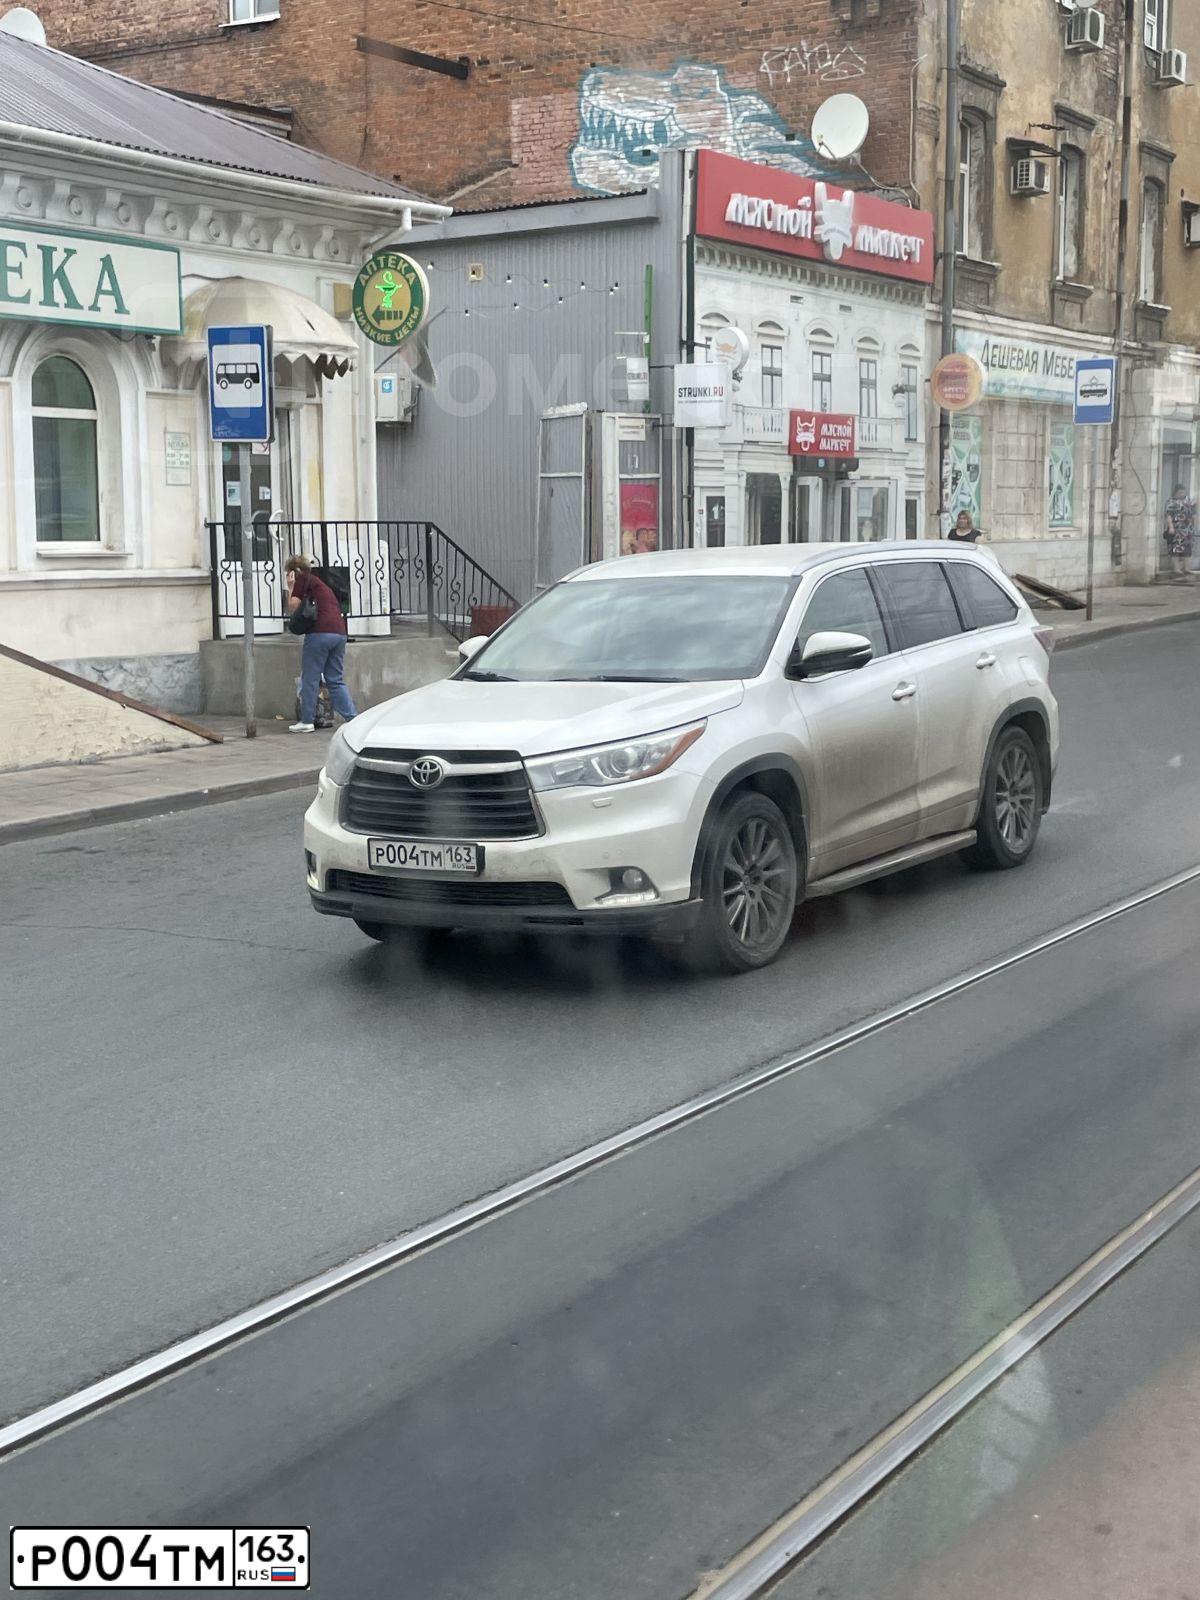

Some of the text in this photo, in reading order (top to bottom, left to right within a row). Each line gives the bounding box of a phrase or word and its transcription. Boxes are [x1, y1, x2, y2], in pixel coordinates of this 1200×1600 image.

[724, 193, 812, 240] МЯСНОЙ
[358, 255, 417, 287] АПТЕКА
[355, 306, 420, 343] НИЗКИЕ ЦЕНЫ
[981, 340, 1039, 374] ДЕШЕВАЯ
[1043, 351, 1075, 379] МЕБЕ
[678, 385, 724, 398] STRUNKI.RU
[820, 416, 853, 438] МЯСНОЙ
[819, 437, 851, 452] МАРКЕТ
[376, 844, 472, 867] Р004ТМ 163
